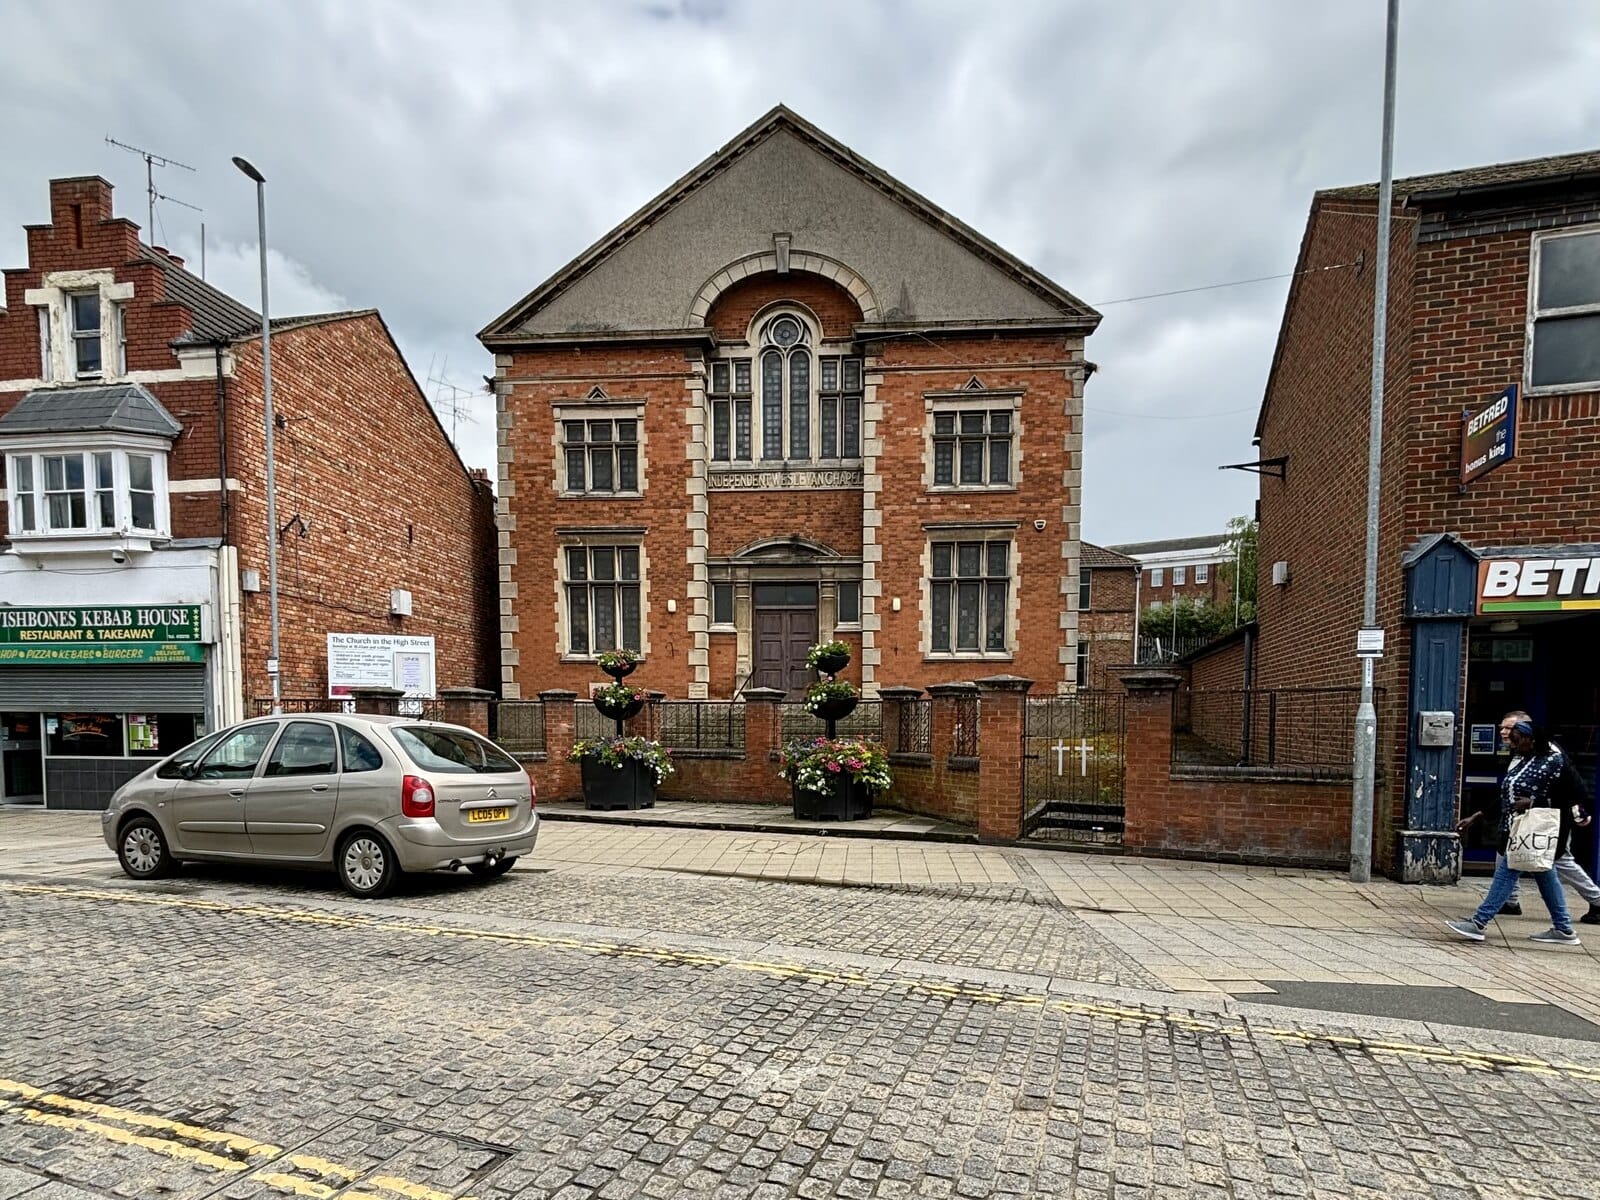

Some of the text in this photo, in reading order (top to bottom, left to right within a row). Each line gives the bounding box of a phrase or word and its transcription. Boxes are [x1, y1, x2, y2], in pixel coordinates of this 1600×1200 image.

[1467, 396, 1508, 437] BETFRED
[1496, 429, 1507, 442] the
[1465, 443, 1506, 474] bonus king
[709, 471, 863, 488] INDEPENDENT WESLEYAN CHAPEL
[0, 608, 190, 628] ISHBONES KEBAB HOUSE
[20, 629, 155, 641] RESTAURANT & TAKEAWAY
[346, 636, 372, 644] Church
[393, 639, 409, 647] High
[26, 649, 51, 659] PIZZA
[58, 649, 94, 659] KEBABS
[102, 649, 144, 659] BURGERS
